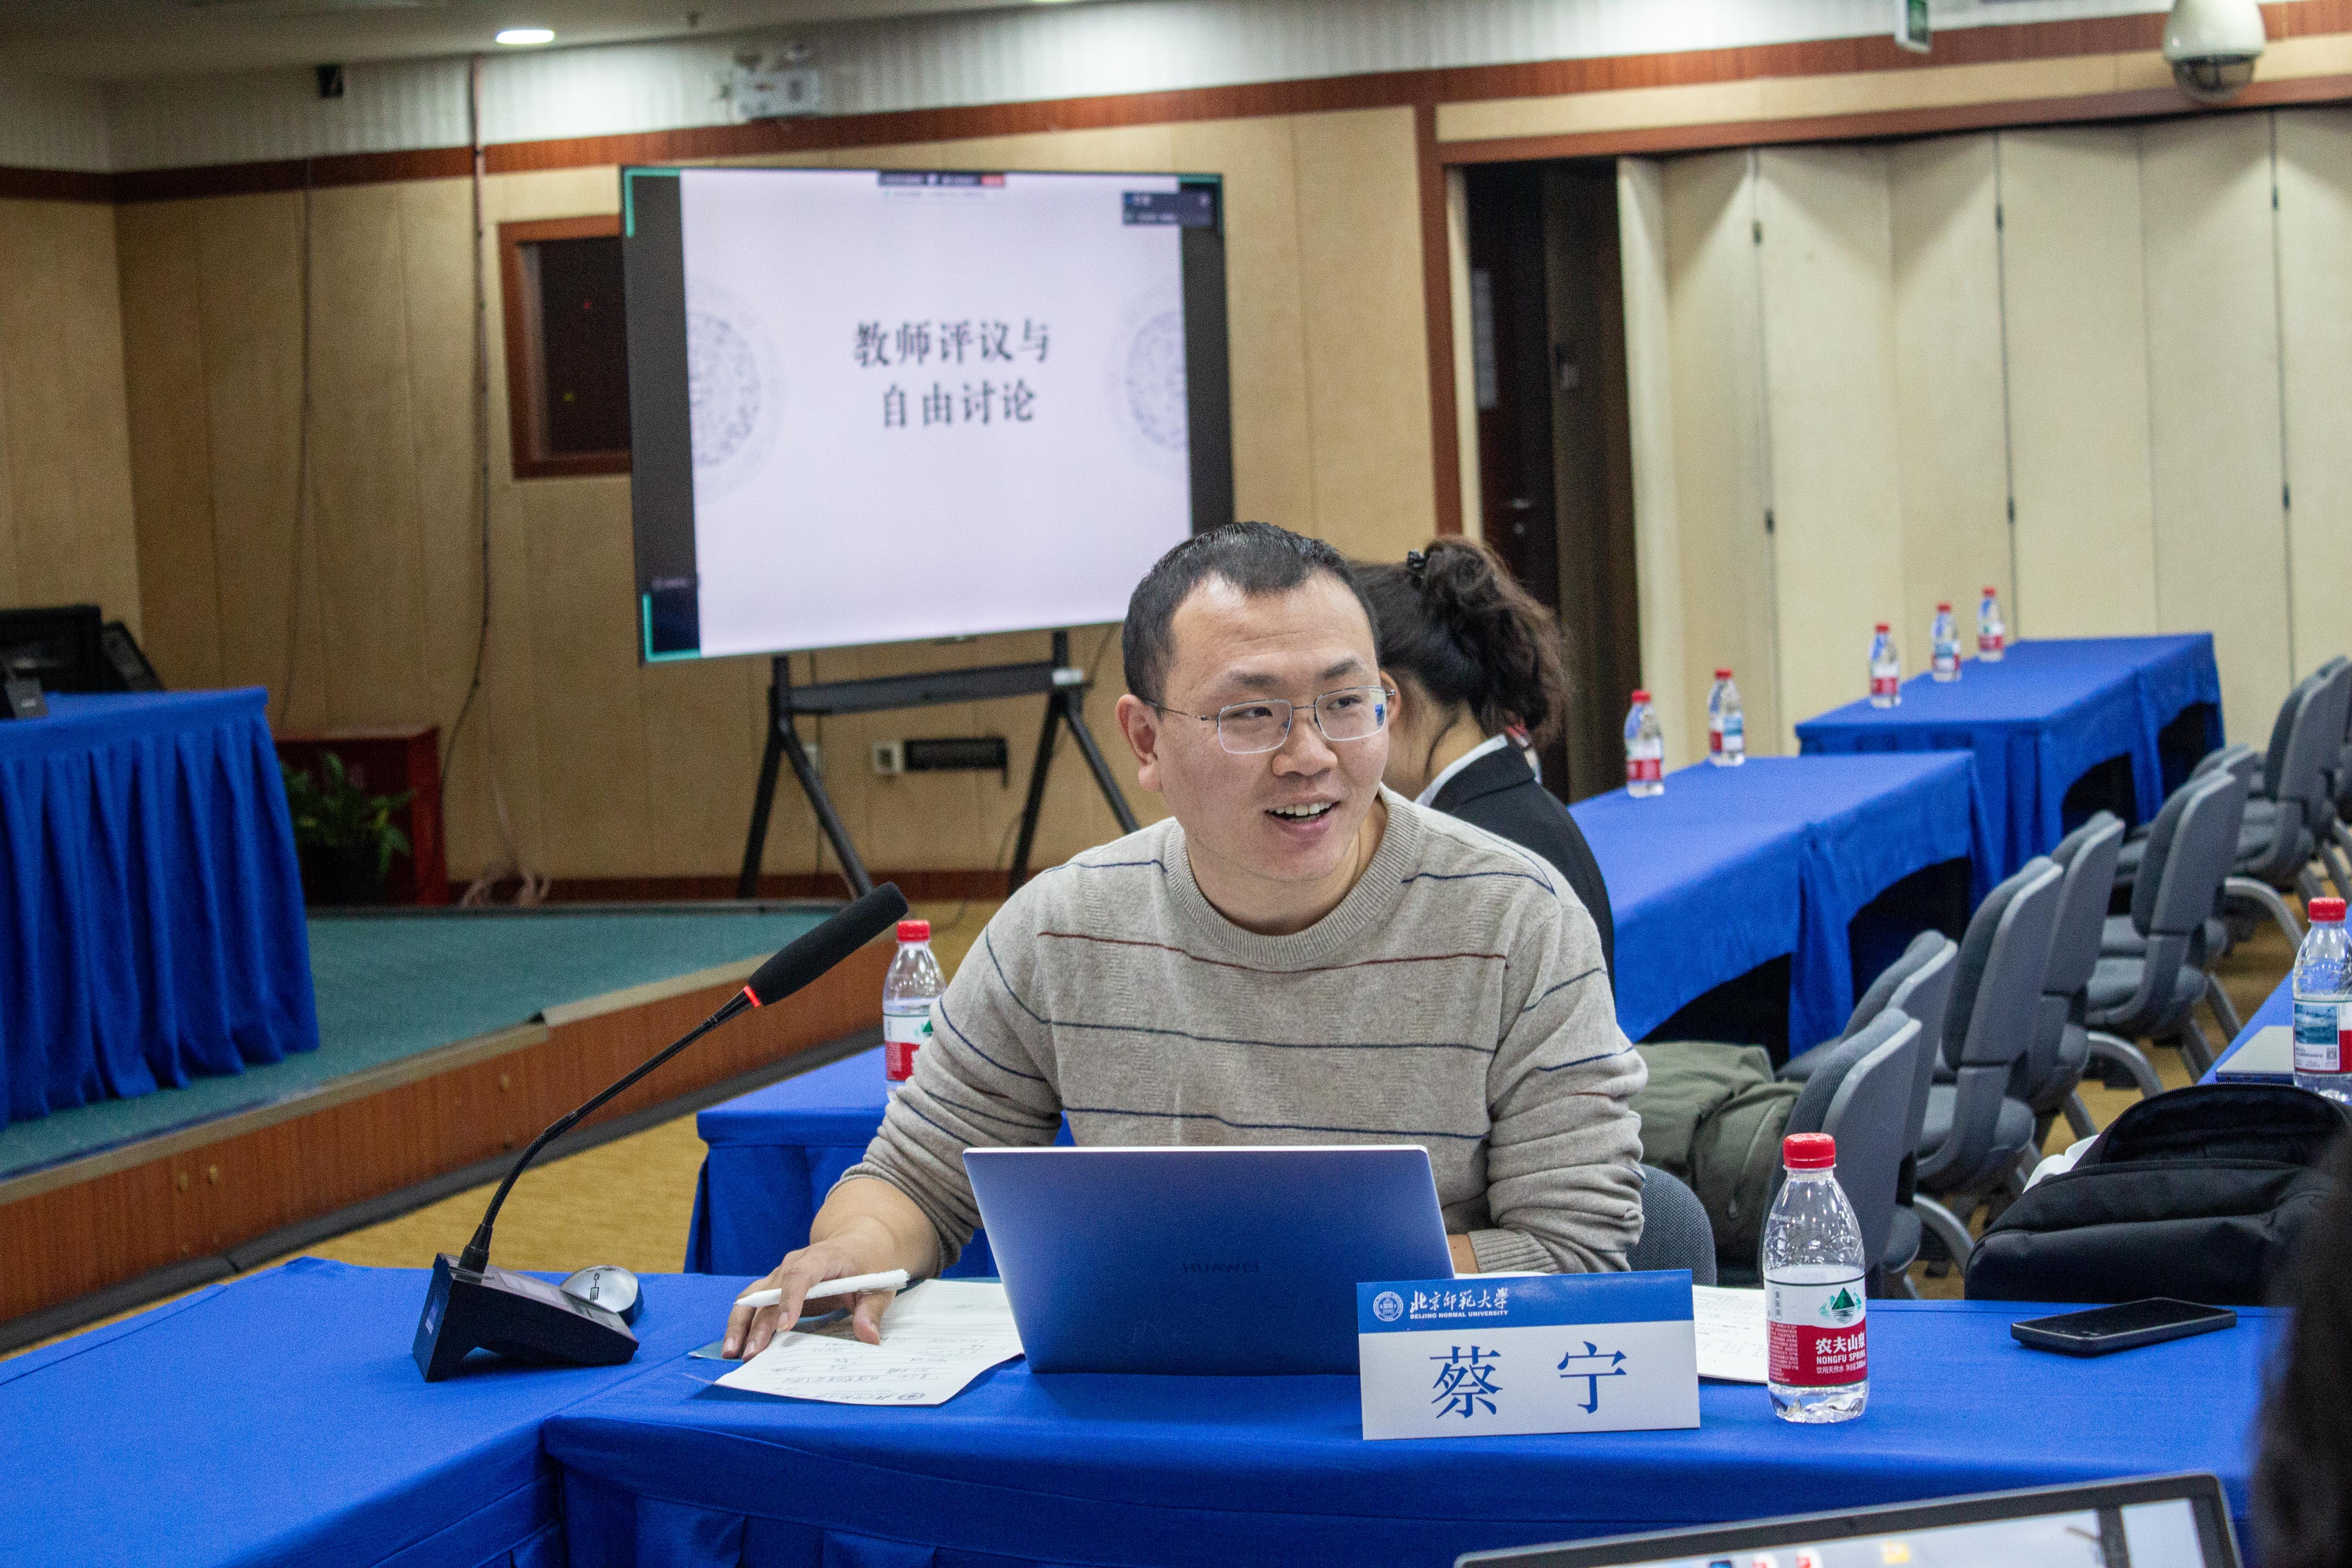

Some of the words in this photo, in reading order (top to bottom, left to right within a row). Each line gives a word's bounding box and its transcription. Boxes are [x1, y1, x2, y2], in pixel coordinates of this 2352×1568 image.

[854, 318, 1049, 366] 教师评议与
[884, 378, 1034, 427] 自由讨论
[1182, 1263, 1259, 1273] HUAWEI
[1815, 1332, 1865, 1355] 农夫山泉
[1817, 1354, 1847, 1365] NONGFU
[1430, 1340, 1627, 1419] 蔡宁
